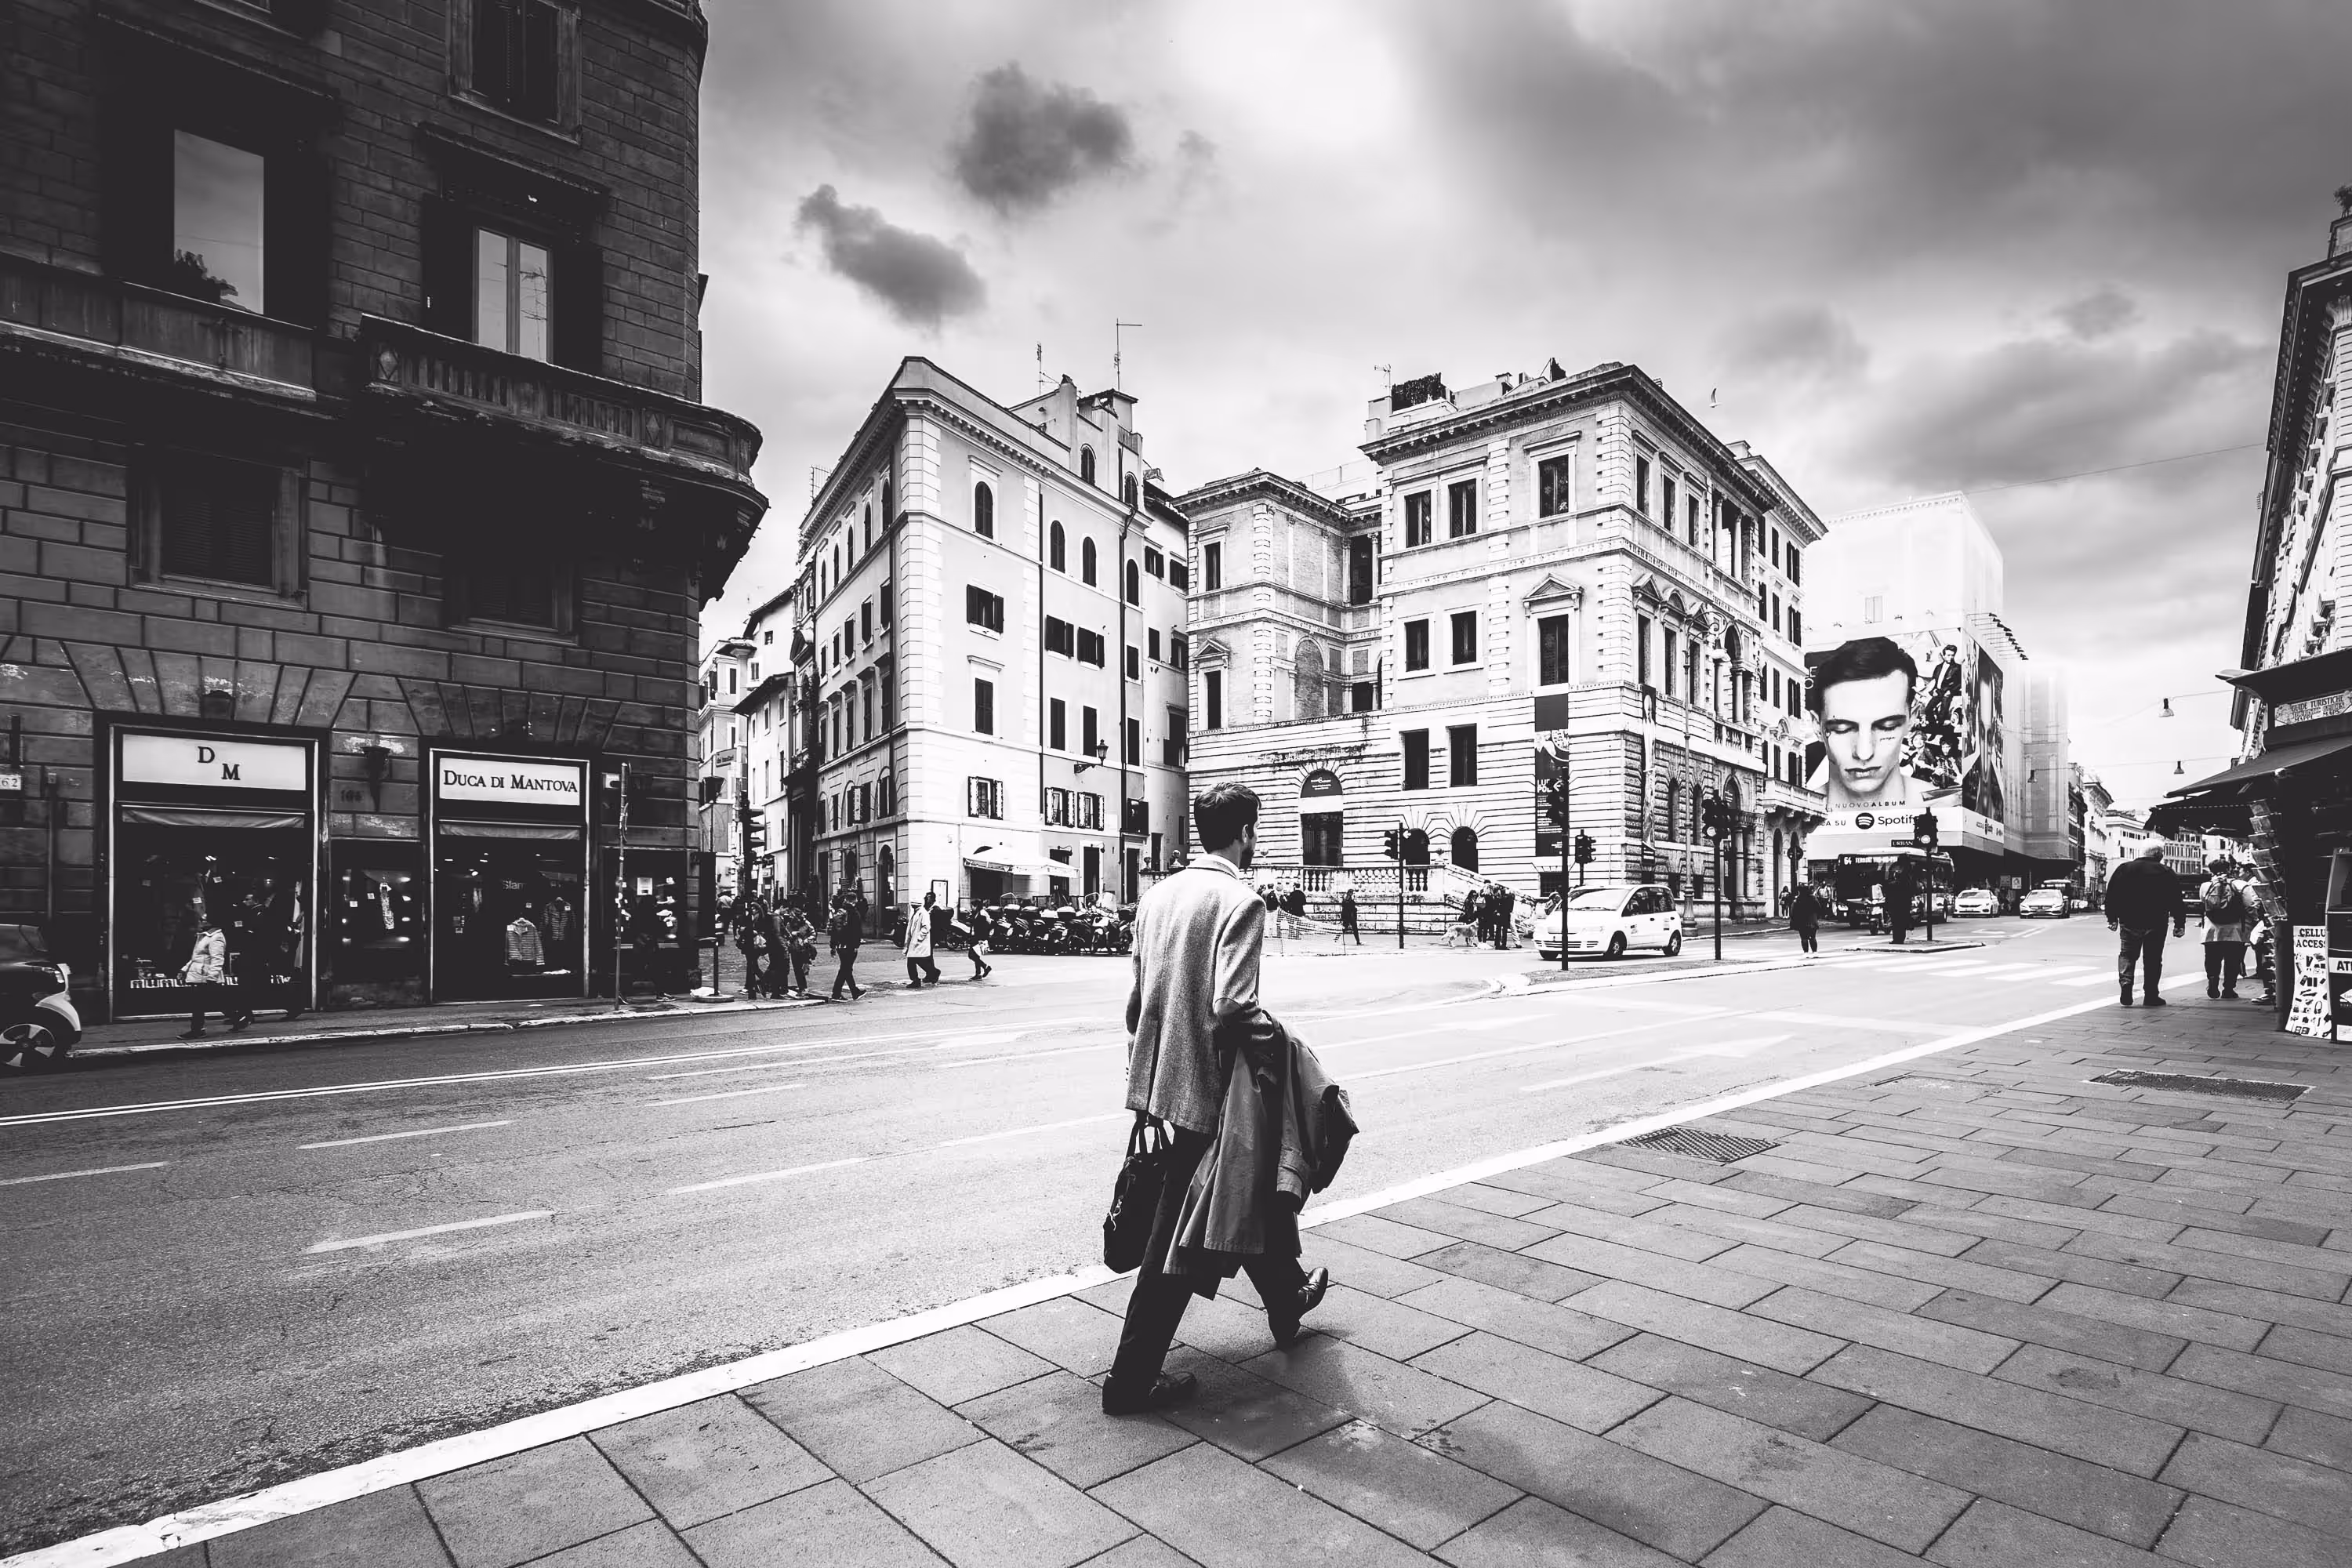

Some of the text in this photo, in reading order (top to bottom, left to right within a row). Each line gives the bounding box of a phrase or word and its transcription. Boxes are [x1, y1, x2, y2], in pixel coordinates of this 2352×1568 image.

[2291, 695, 2344, 712] GUIDE TURISTICHE
[197, 746, 241, 781] D M
[0, 777, 18, 788] 62
[443, 769, 579, 793] DUCA DI MANTOVA
[1878, 814, 1914, 826] Spotif
[1844, 856, 1853, 866] 64
[2336, 960, 2352, 971] AT
